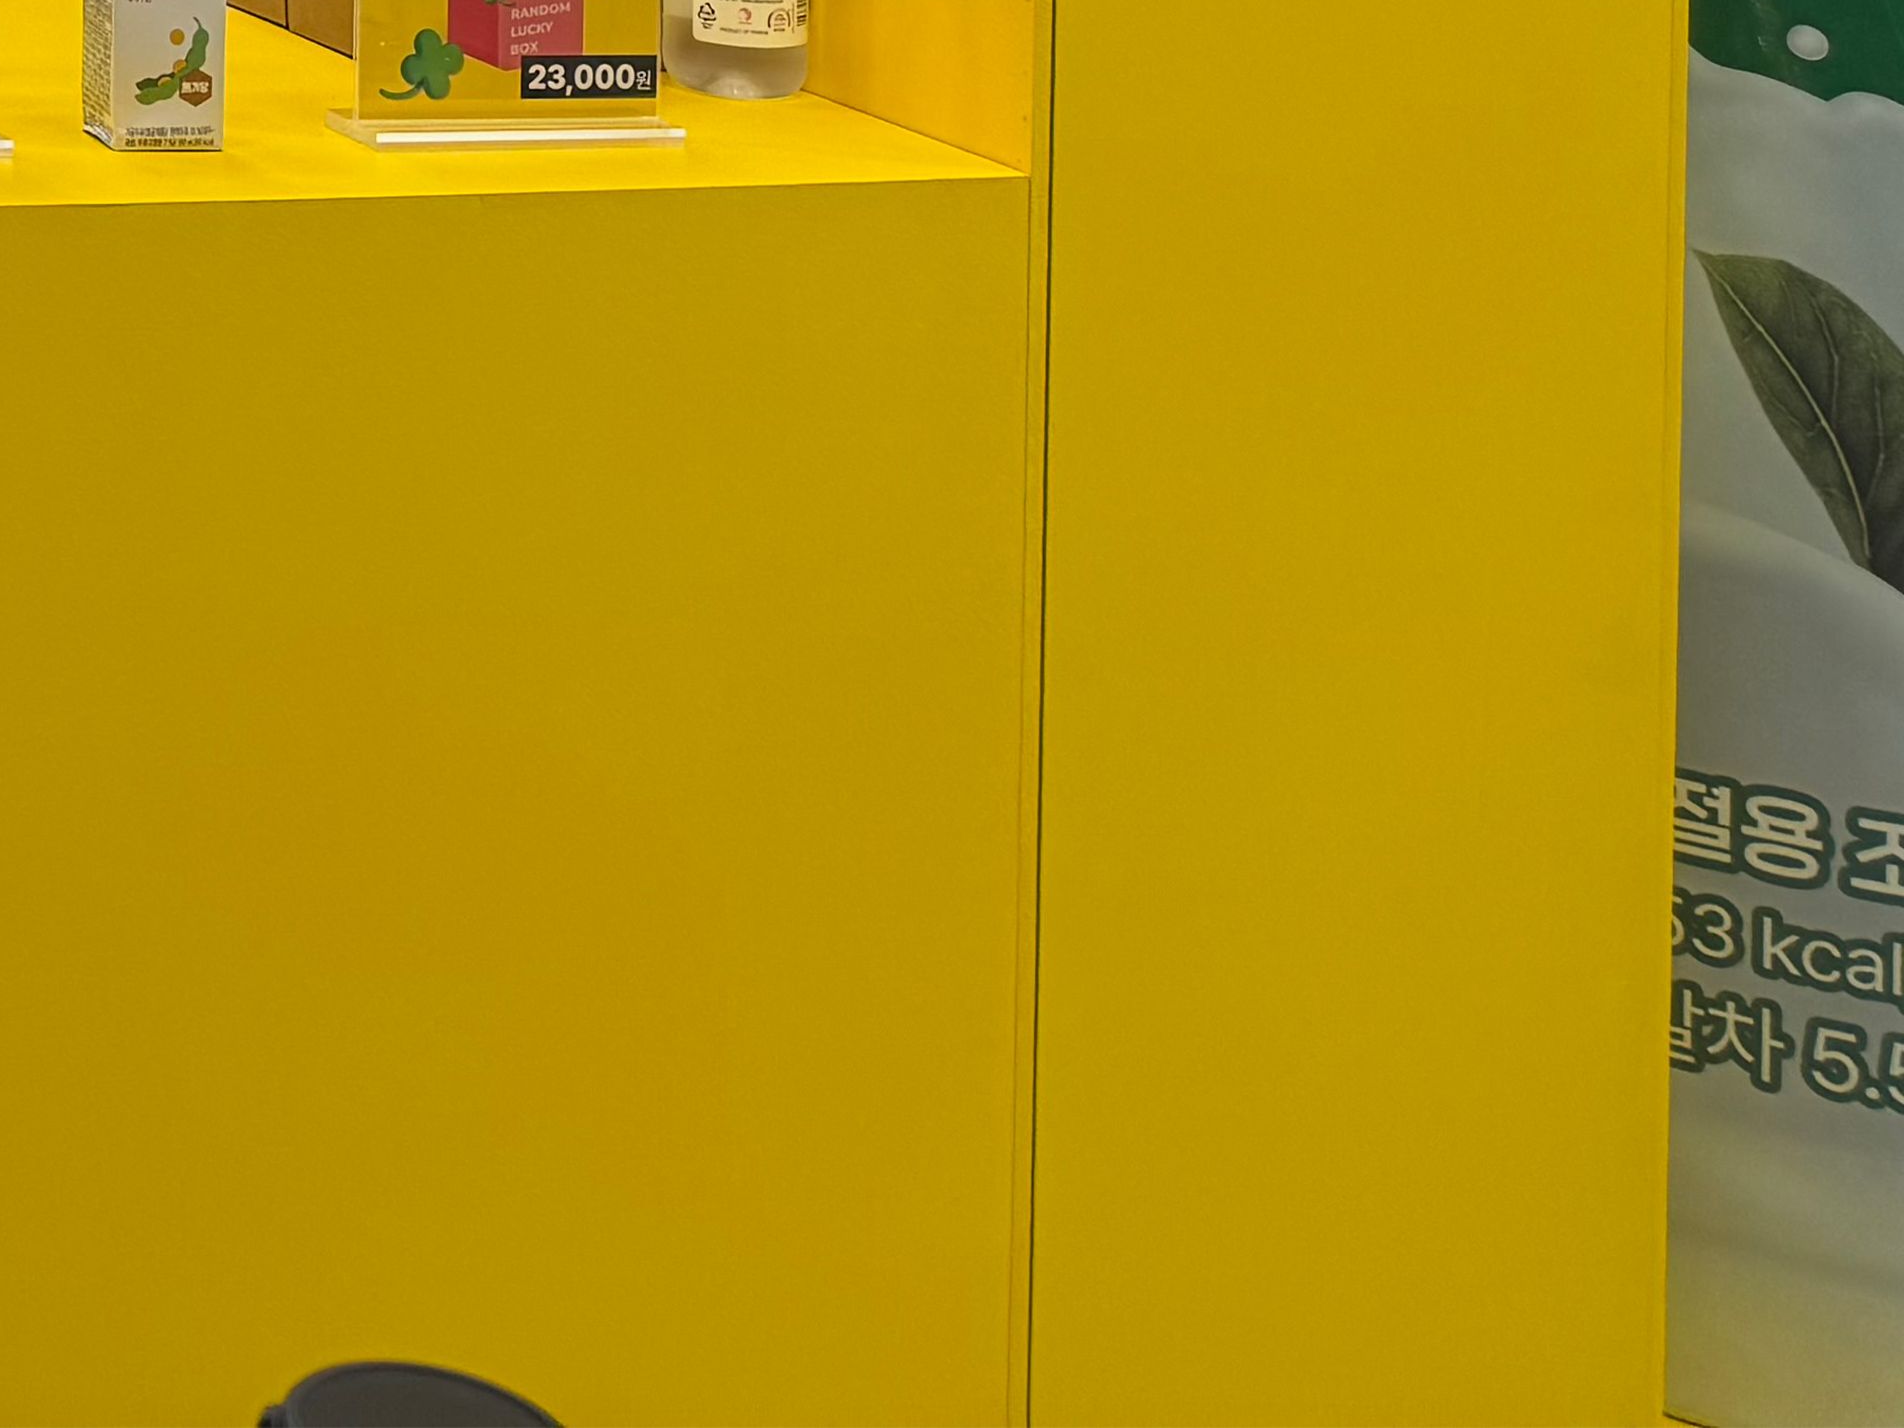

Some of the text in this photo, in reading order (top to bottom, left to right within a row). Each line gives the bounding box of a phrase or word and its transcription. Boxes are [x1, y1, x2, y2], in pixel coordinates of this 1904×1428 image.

[511, 2, 572, 20] RANDOM
[511, 22, 554, 38] LUCKY
[510, 42, 538, 55] BOX
[528, 63, 651, 96] 23,000원
